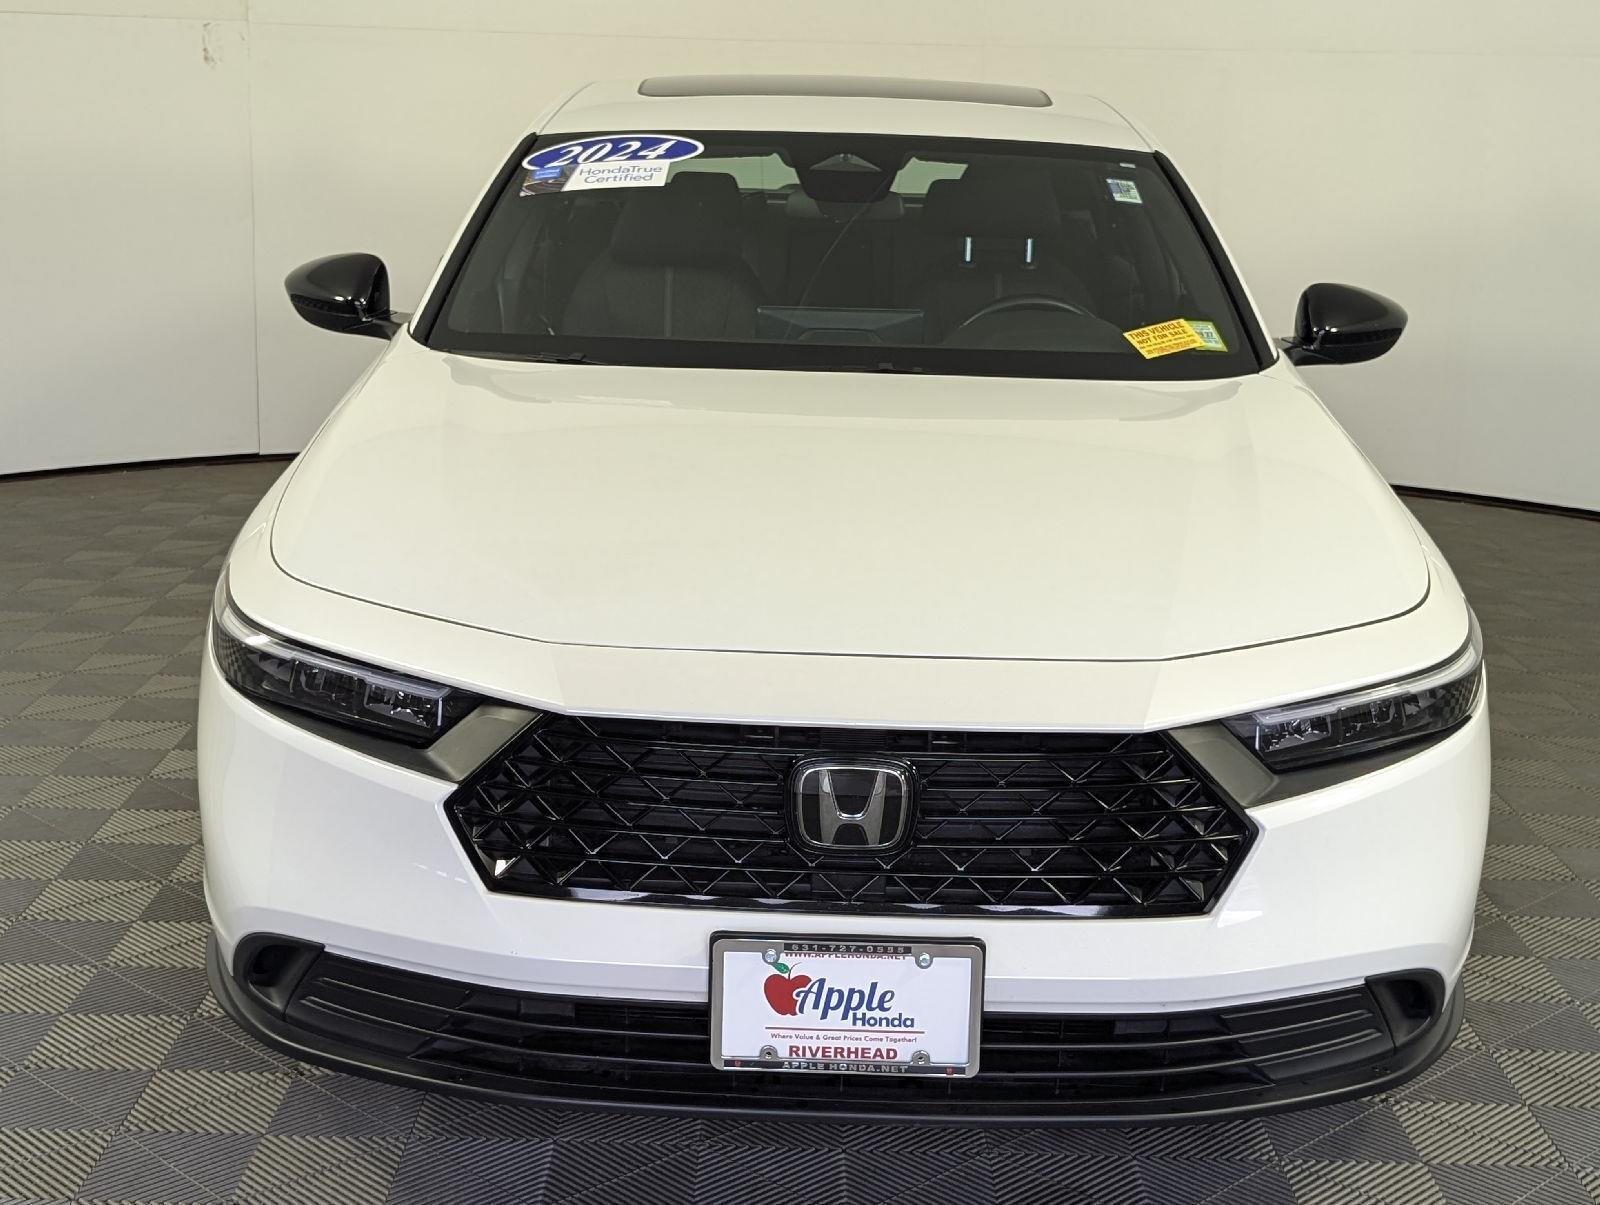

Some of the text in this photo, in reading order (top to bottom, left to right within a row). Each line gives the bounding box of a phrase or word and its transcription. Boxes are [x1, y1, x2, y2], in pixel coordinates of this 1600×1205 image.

[543, 140, 678, 168] 2024
[579, 165, 663, 176] HondaTrue
[584, 173, 653, 184] Certified
[1127, 329, 1149, 341] THIS
[1148, 321, 1185, 335] VEHICLE
[1136, 336, 1152, 345] NOT
[1152, 333, 1169, 342] FOR
[1169, 328, 1188, 338] SALE
[795, 977, 895, 1021] Apple
[852, 1012, 915, 1028] Honda
[770, 1032, 793, 1040] Where
[795, 1033, 814, 1041] Value
[885, 1036, 918, 1045] Together!
[788, 1045, 898, 1060] RIVERHEAD
[782, 1061, 909, 1073] APPLE HONDA.NET
